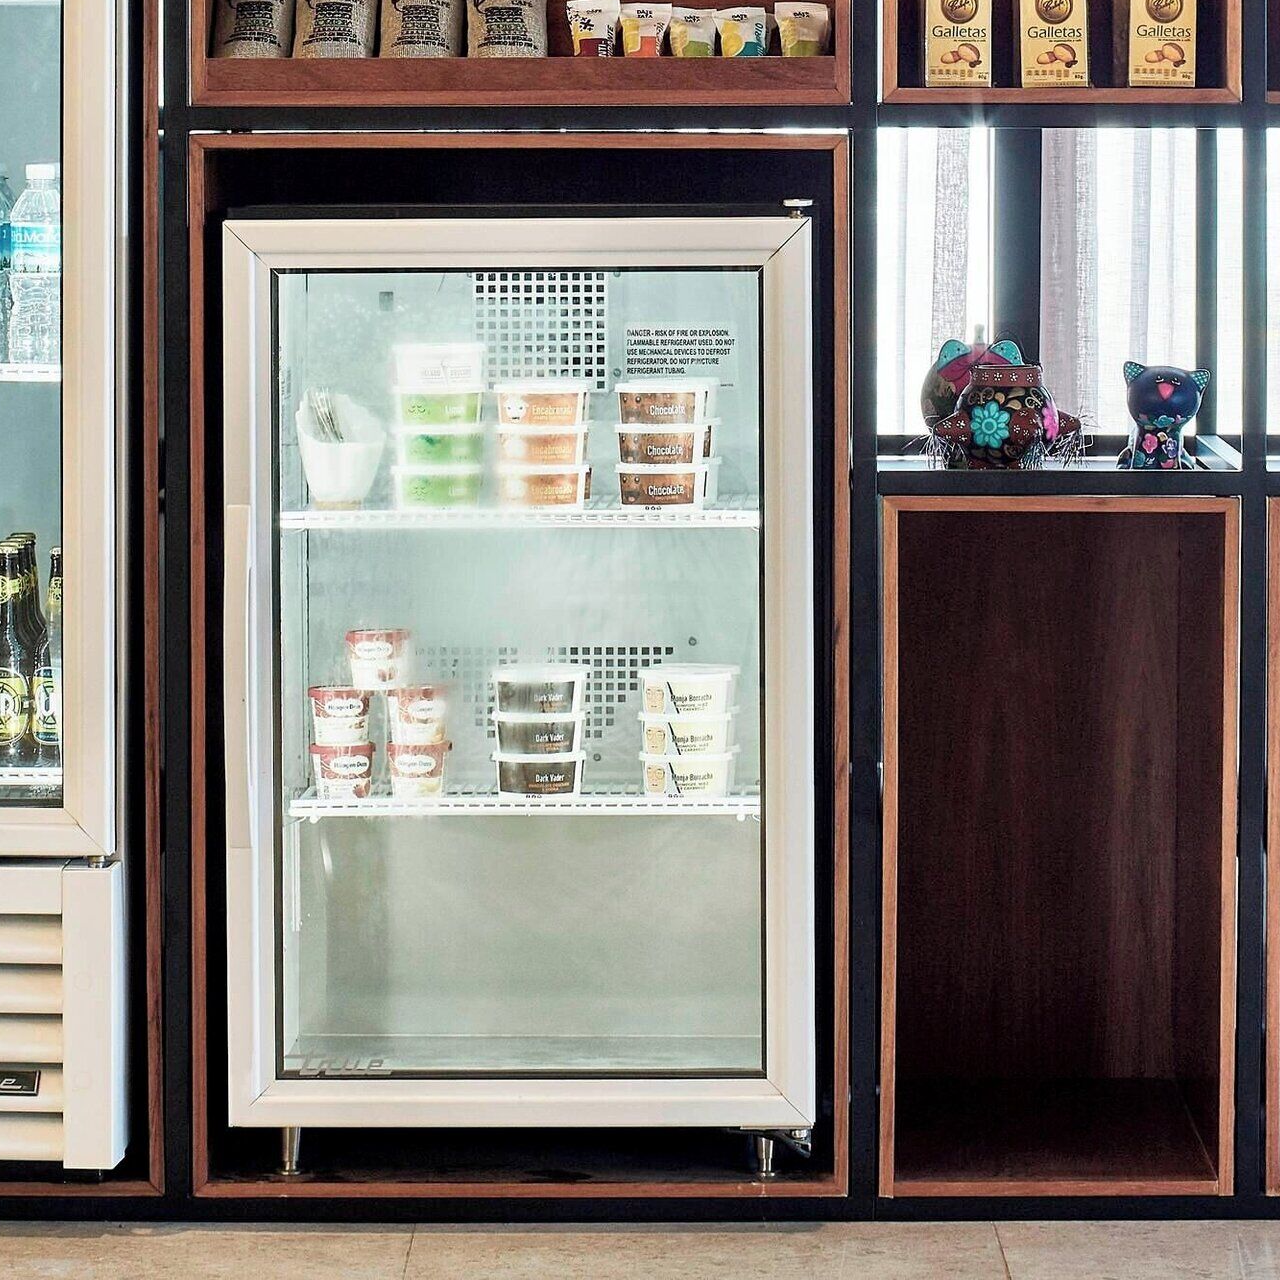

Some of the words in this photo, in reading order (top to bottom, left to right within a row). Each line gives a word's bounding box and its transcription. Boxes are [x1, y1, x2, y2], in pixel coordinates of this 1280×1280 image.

[932, 25, 987, 39] Galletas
[1027, 25, 1082, 39] Galletas
[1136, 24, 1191, 38] Galletas
[650, 405, 686, 416] Chocolate
[647, 445, 683, 456] Chocolate
[648, 485, 684, 496] Chocolate
[536, 734, 548, 742] Dark
[536, 774, 548, 782] Dark
